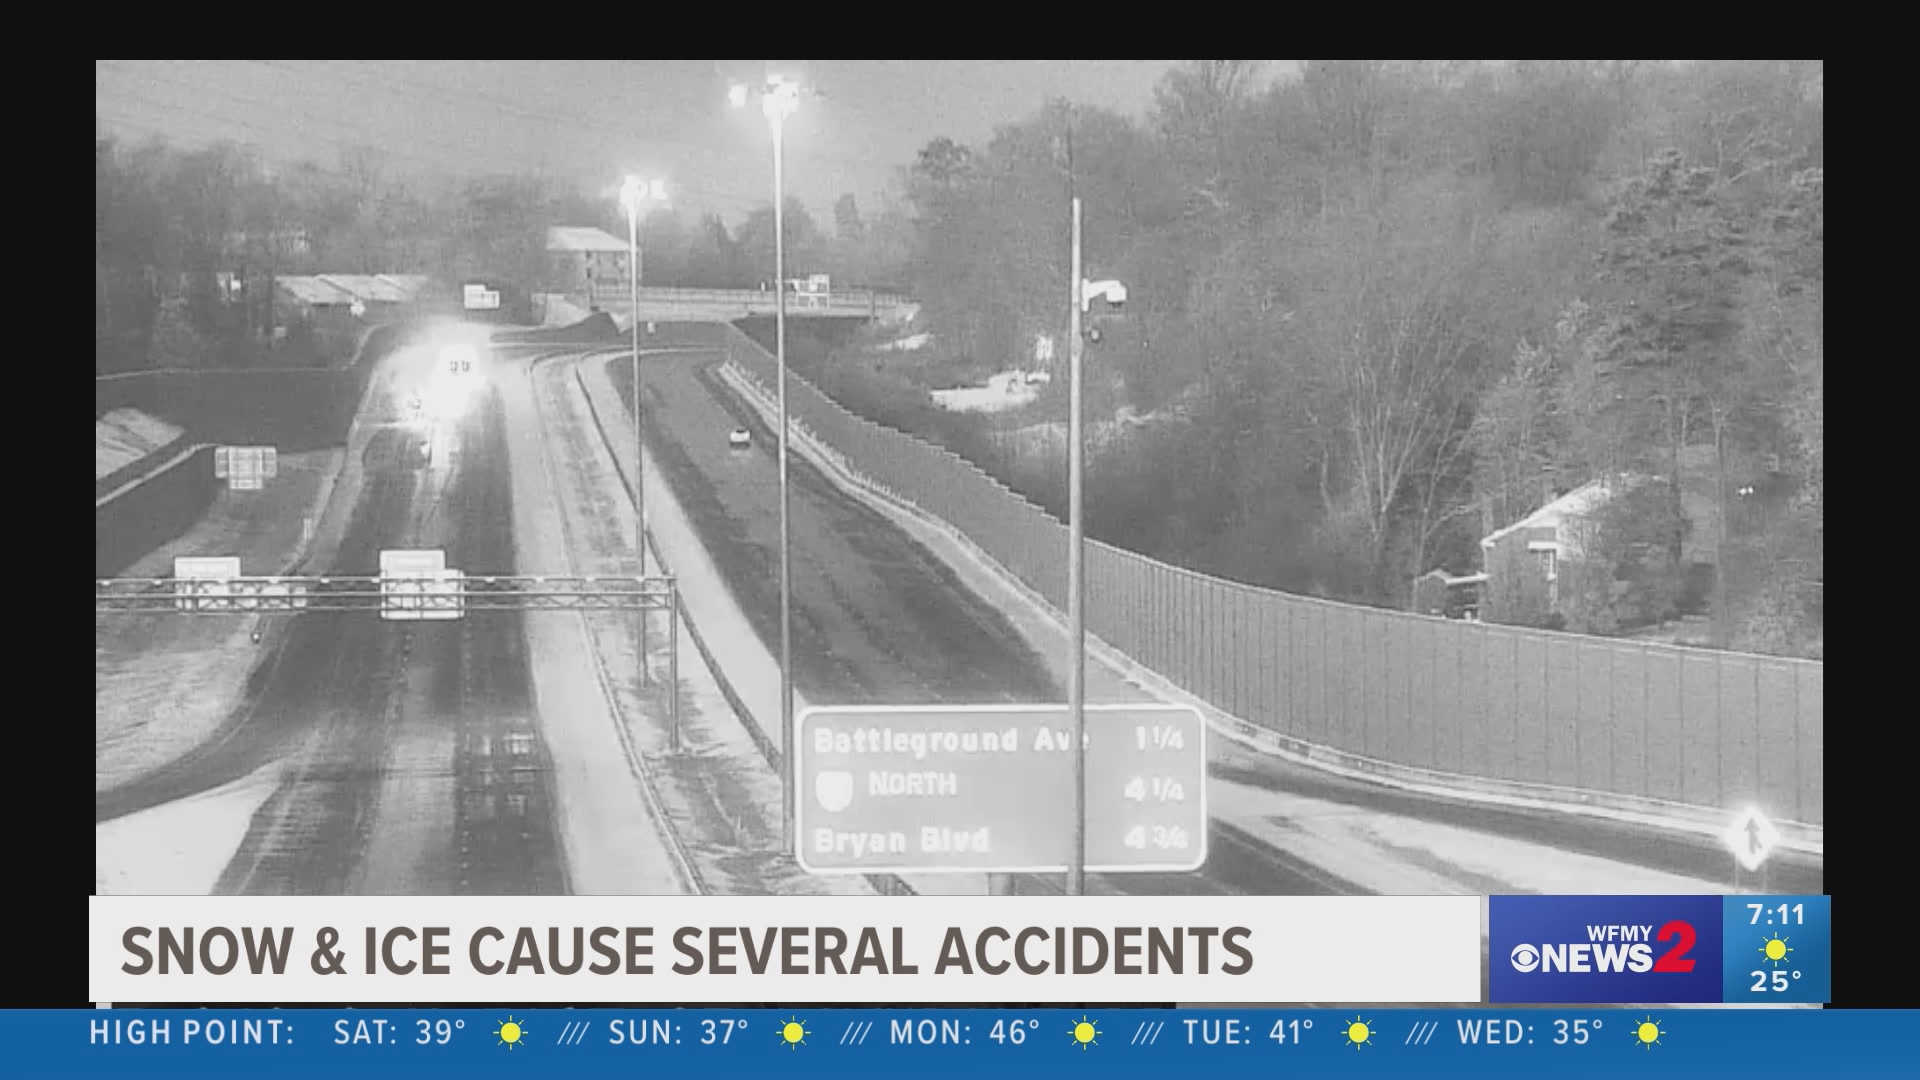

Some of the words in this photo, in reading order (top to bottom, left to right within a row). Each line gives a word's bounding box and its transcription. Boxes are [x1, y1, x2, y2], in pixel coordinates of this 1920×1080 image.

[814, 726, 1018, 759] Battleground
[868, 771, 957, 797] NORTH
[814, 828, 906, 858] Bryan
[920, 826, 991, 853] Blvd
